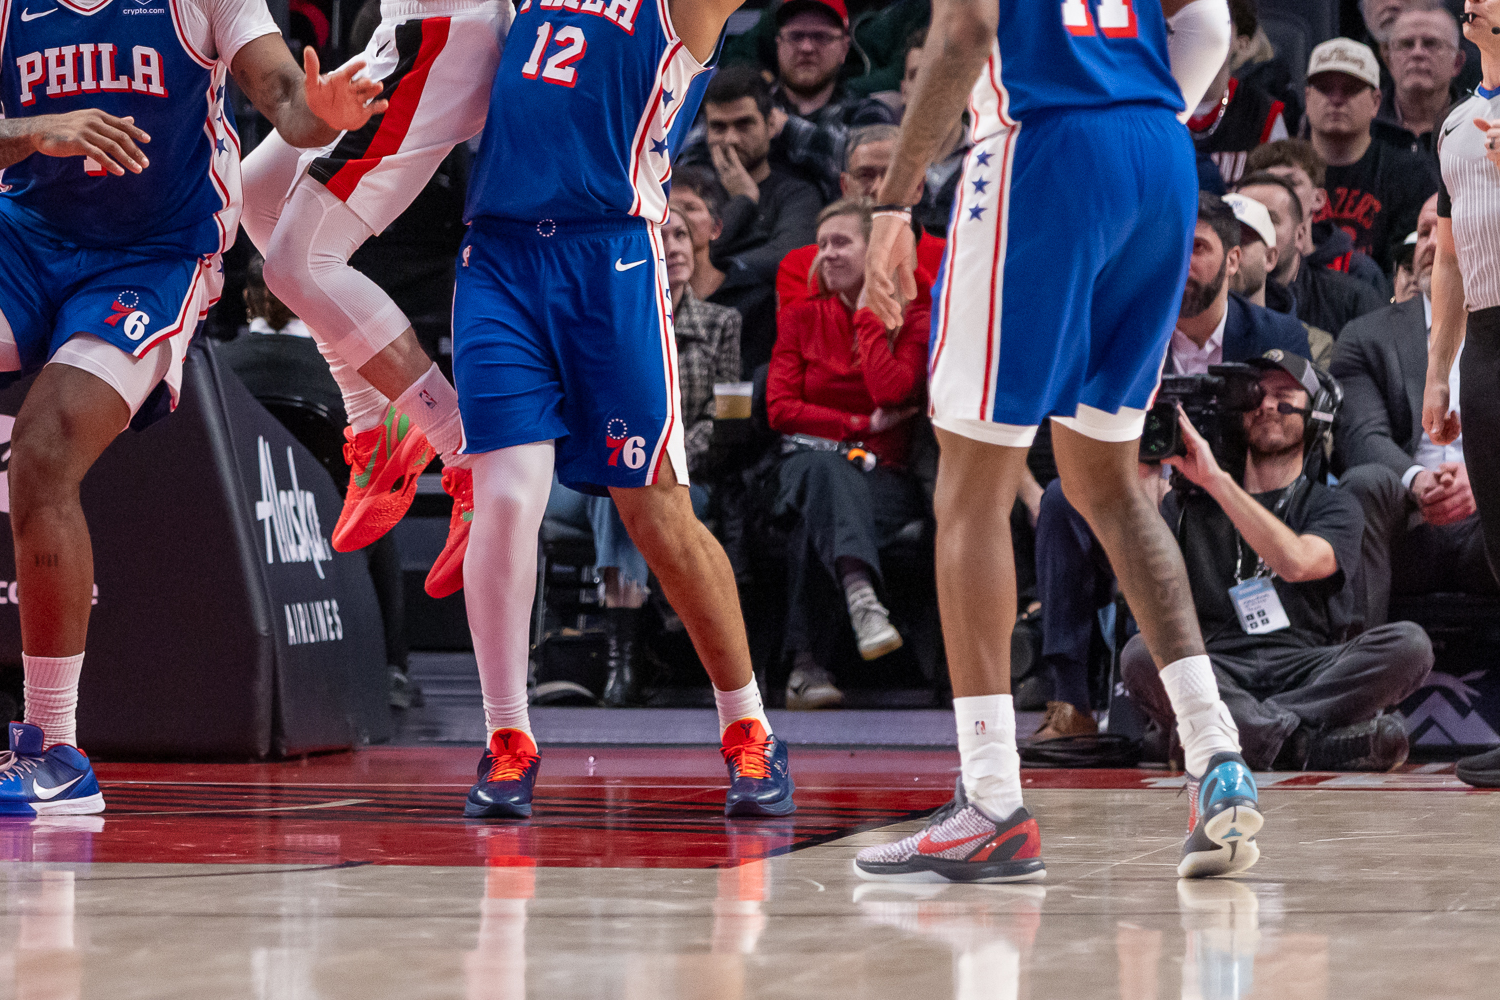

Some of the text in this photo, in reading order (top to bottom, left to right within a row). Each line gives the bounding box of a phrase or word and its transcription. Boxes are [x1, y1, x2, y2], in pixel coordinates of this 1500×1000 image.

[122, 6, 165, 16] crypto.com
[16, 42, 169, 107] PHILA
[521, 20, 588, 89] 12
[605, 435, 647, 470] 76
[283, 598, 344, 646] AIRLINES
